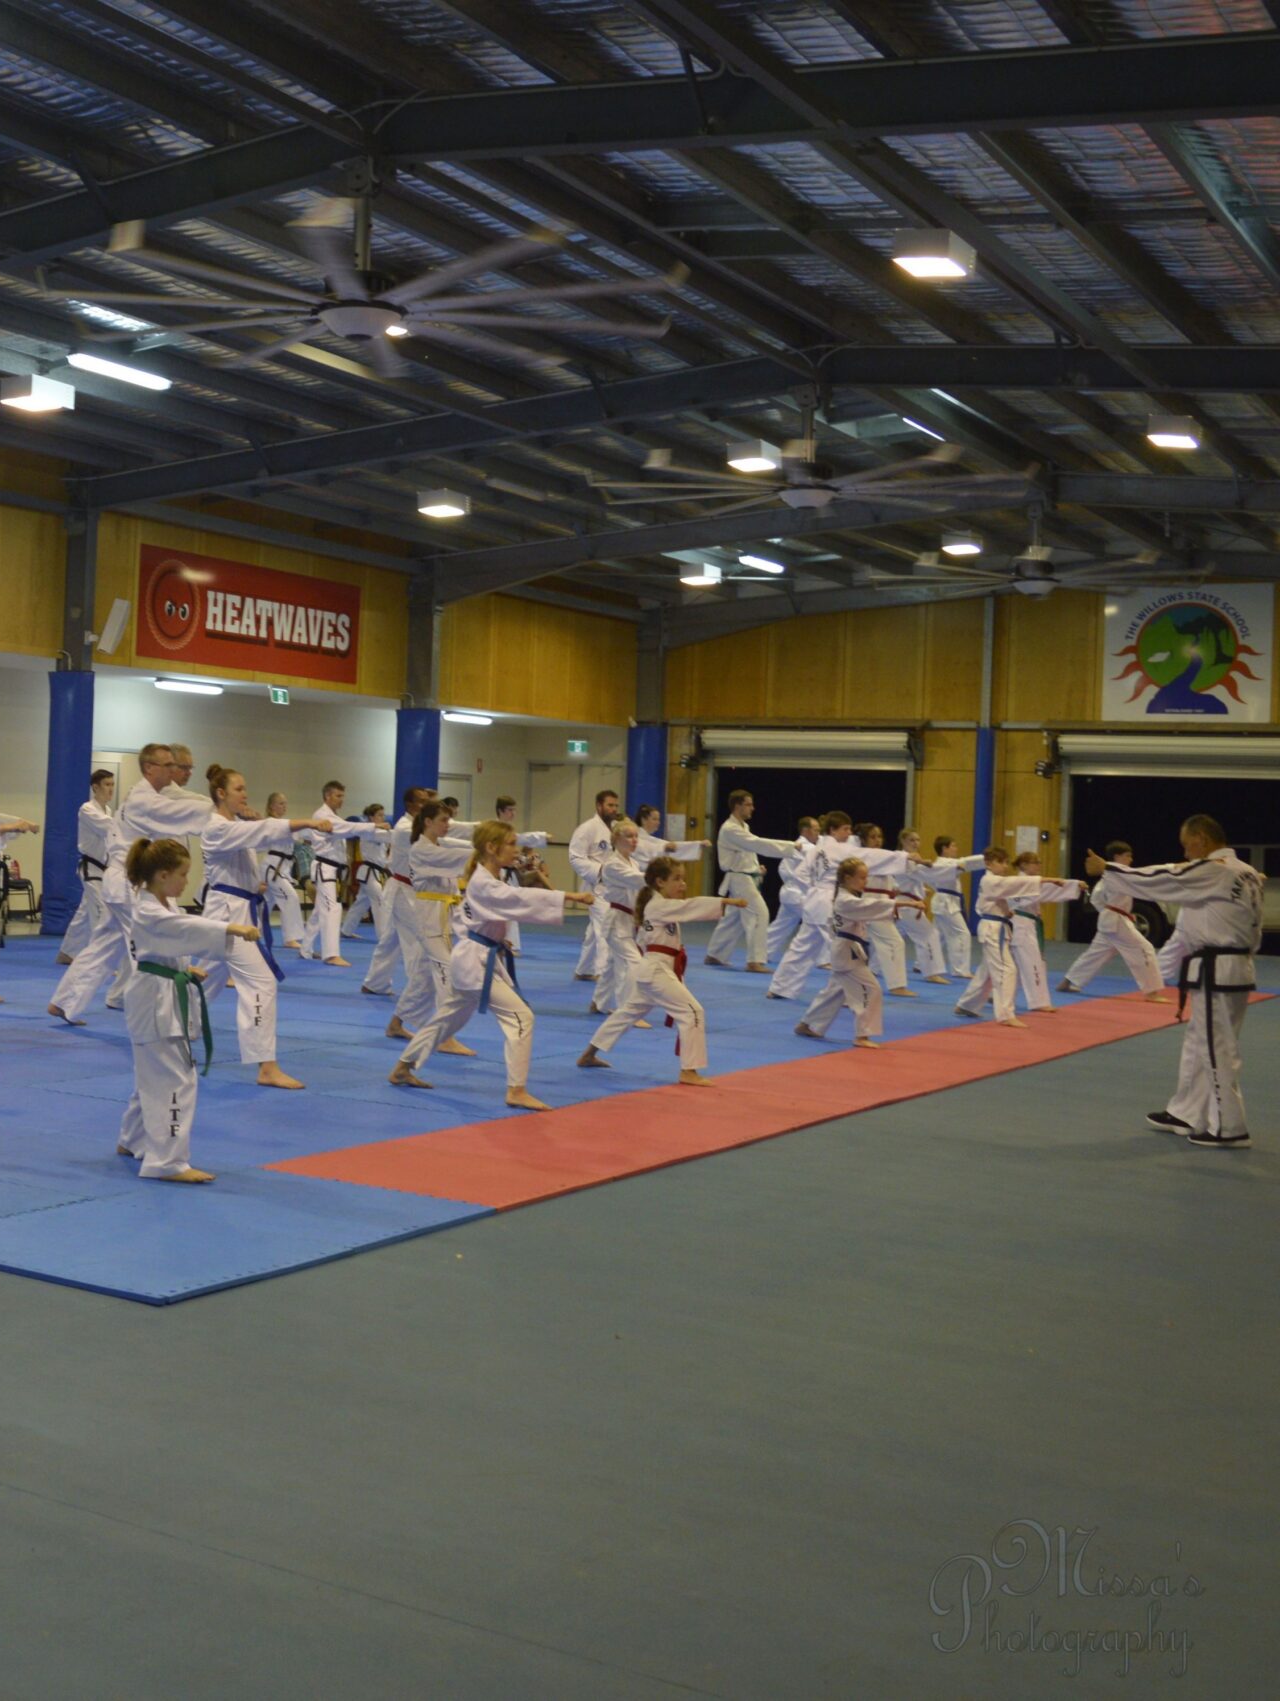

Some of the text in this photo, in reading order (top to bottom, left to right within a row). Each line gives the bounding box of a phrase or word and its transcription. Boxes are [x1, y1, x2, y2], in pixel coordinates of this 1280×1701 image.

[205, 590, 351, 651] HEATWAVES
[1125, 591, 1251, 640] THE WILLOWS STATE SCHOOL
[254, 993, 263, 1027] ITF
[169, 1092, 180, 1137] ITF
